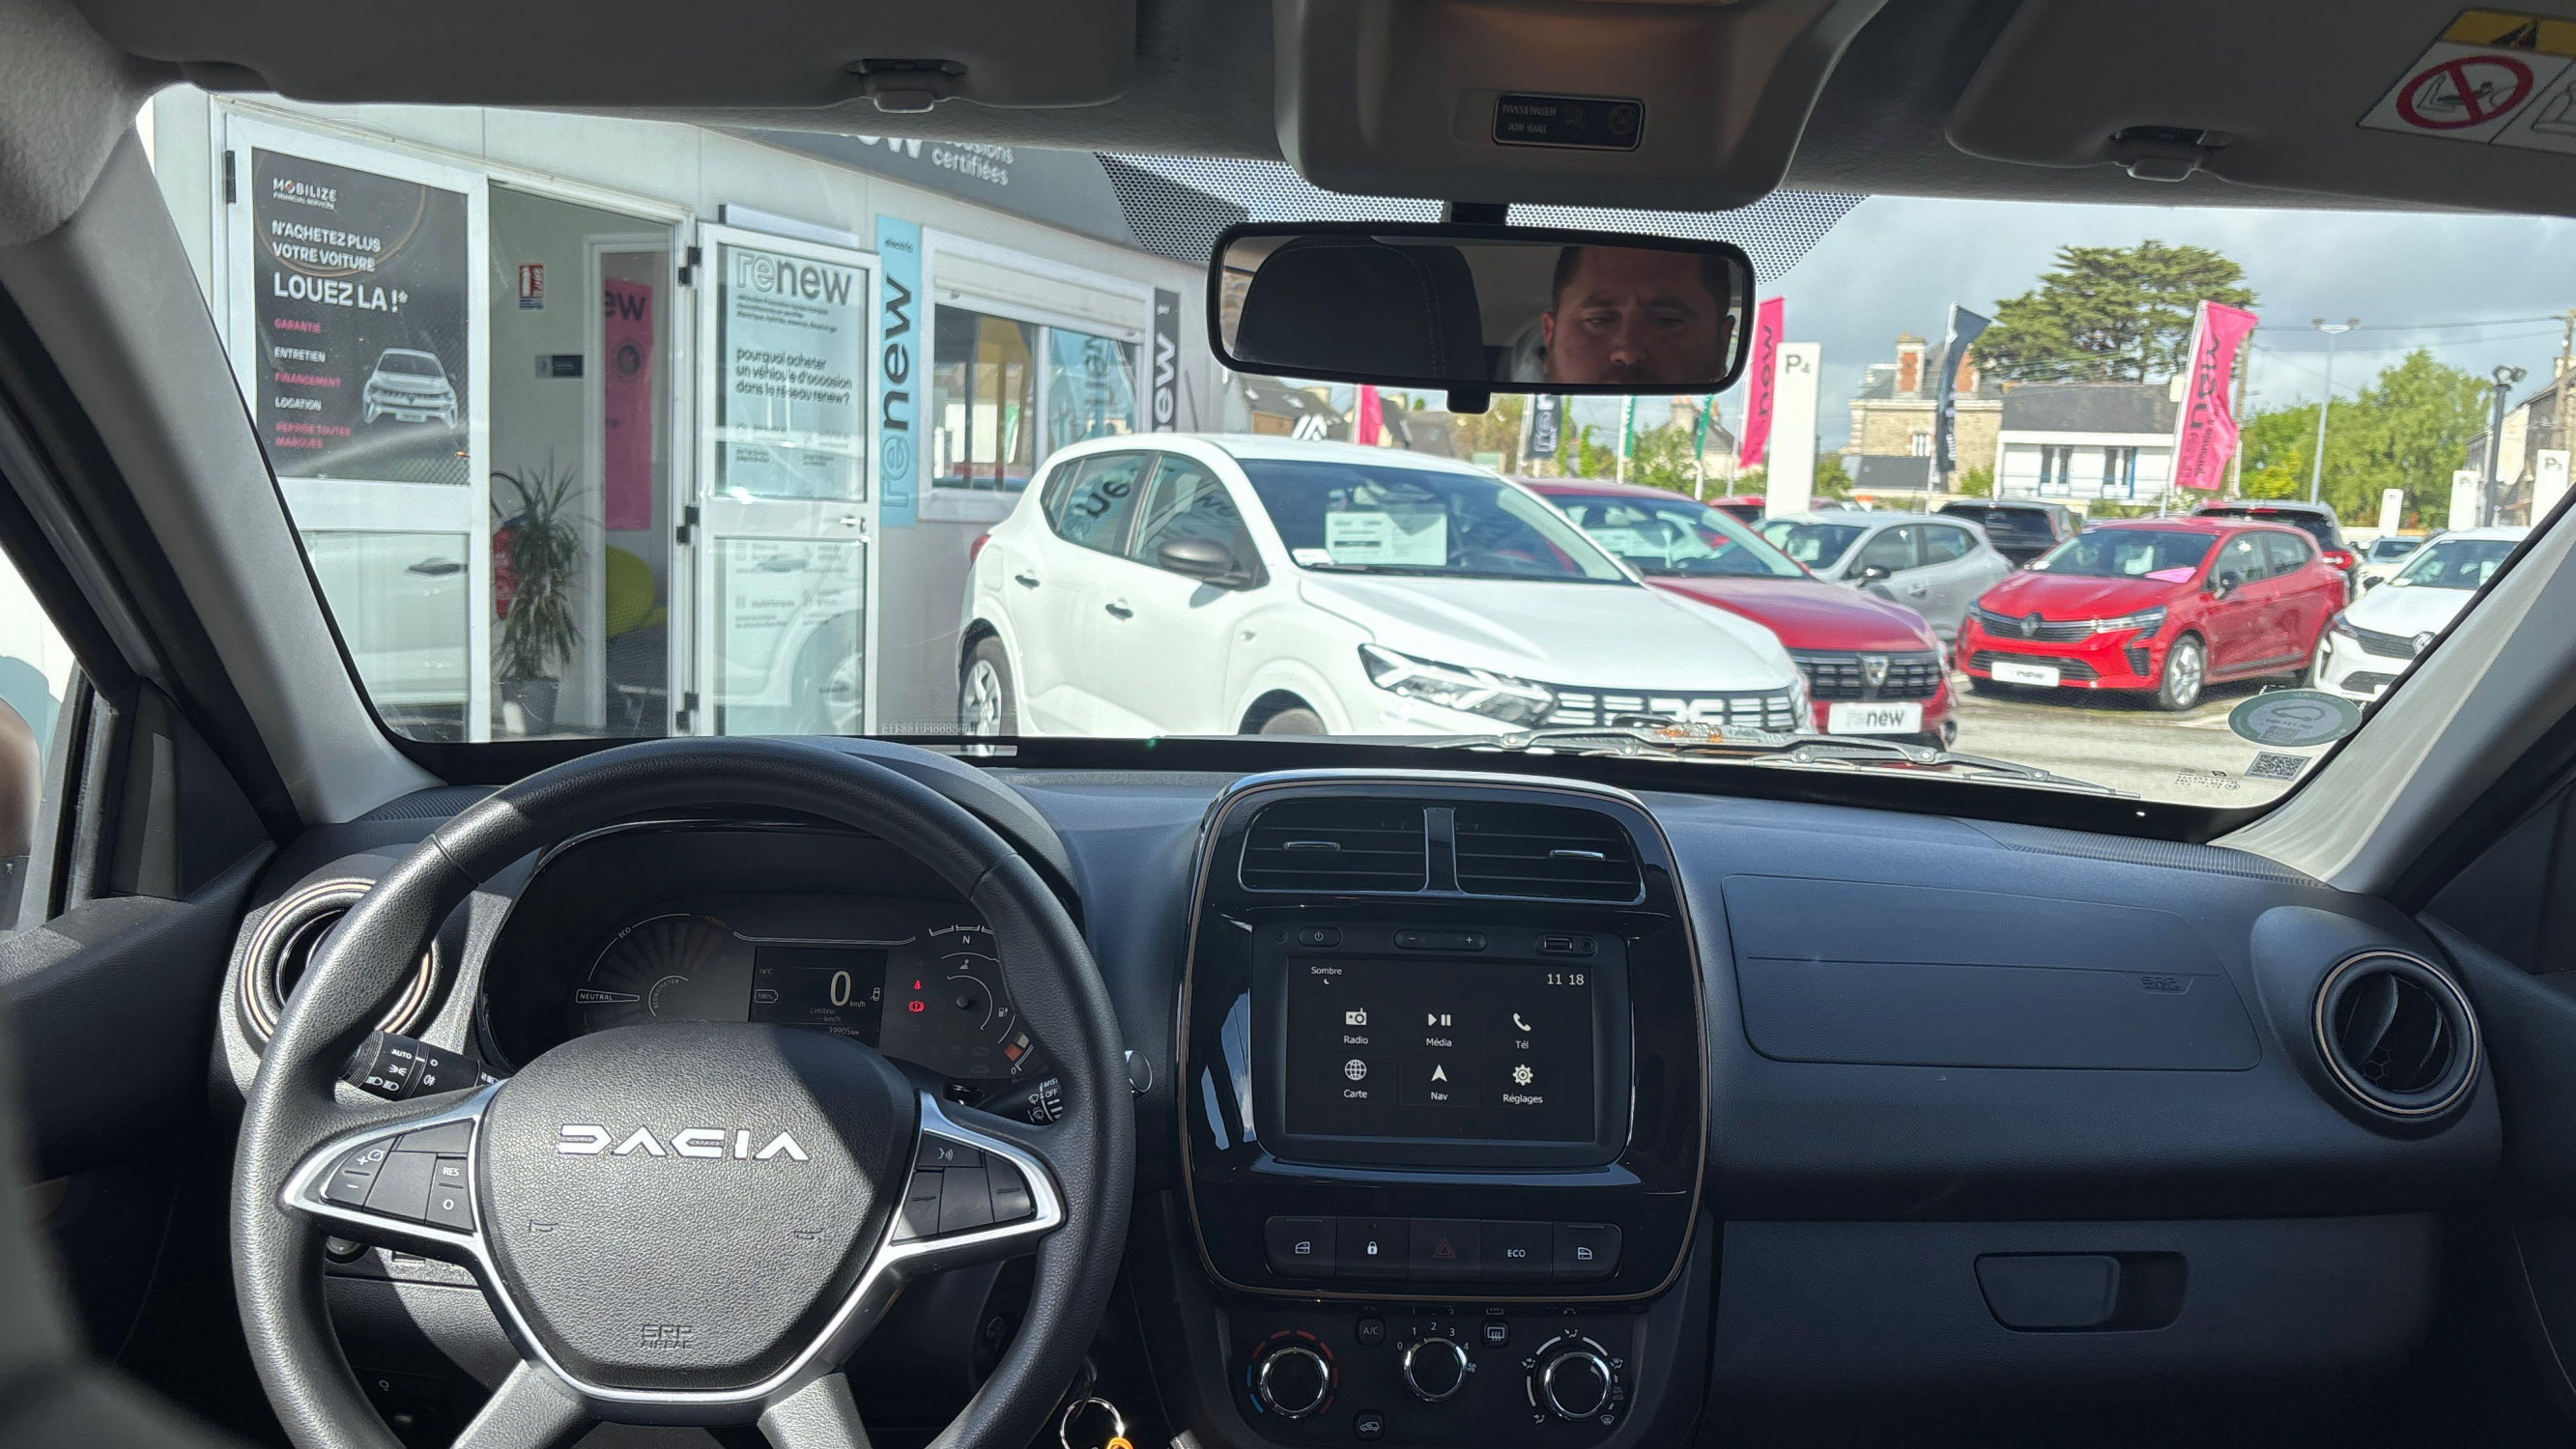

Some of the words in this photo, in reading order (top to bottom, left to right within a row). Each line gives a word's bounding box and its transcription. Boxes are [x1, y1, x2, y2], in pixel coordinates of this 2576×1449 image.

[930, 147, 1009, 186] certifiées
[272, 178, 337, 202] MOBILIZE
[272, 220, 346, 247] N'ACHETEZ
[347, 234, 382, 252] PLUS
[272, 242, 318, 263] VOTRE
[319, 248, 376, 271] VOITURE
[735, 250, 852, 306] renew
[273, 272, 354, 307] LOUEZ
[358, 284, 388, 312] LA
[273, 318, 322, 334] GARANTIE
[273, 346, 327, 363] ENTRETIEN
[736, 349, 786, 365] pourquoi
[787, 353, 826, 370] acheter
[274, 371, 341, 388] FINANCEMENT
[735, 365, 751, 378] un
[752, 367, 796, 384] véhicule
[797, 371, 852, 389] d'occasion
[735, 380, 764, 396] dans
[765, 383, 775, 397] le
[880, 271, 912, 508] renew
[274, 396, 323, 412] LOCATION
[617, 926, 632, 939] ECO
[962, 935, 971, 945] N
[1310, 966, 1343, 976] Sombre
[1546, 973, 1563, 986] 11
[1568, 973, 1585, 986] 18
[830, 970, 851, 1007] 0
[580, 992, 614, 1001] NEUTRAL
[810, 1007, 838, 1015] Limiteur
[1343, 1035, 1369, 1045] Radio
[1425, 1037, 1452, 1048] Média
[1514, 1038, 1530, 1050] Tél
[390, 1048, 413, 1061] AUTO
[1045, 1089, 1059, 1098] OFF
[1343, 1088, 1368, 1099] Carte
[1430, 1092, 1448, 1101] Nav
[1503, 1093, 1544, 1105] Réglages
[558, 1122, 811, 1161] DACIA
[442, 1166, 461, 1178] RES
[1505, 1249, 1527, 1259] ECO
[1362, 1326, 1380, 1335] A/C
[1412, 1326, 1417, 1336] 1
[1430, 1321, 1437, 1331] 2
[1448, 1327, 1456, 1337] 3
[1396, 1341, 1403, 1350] 0
[1463, 1342, 1470, 1350] 4
